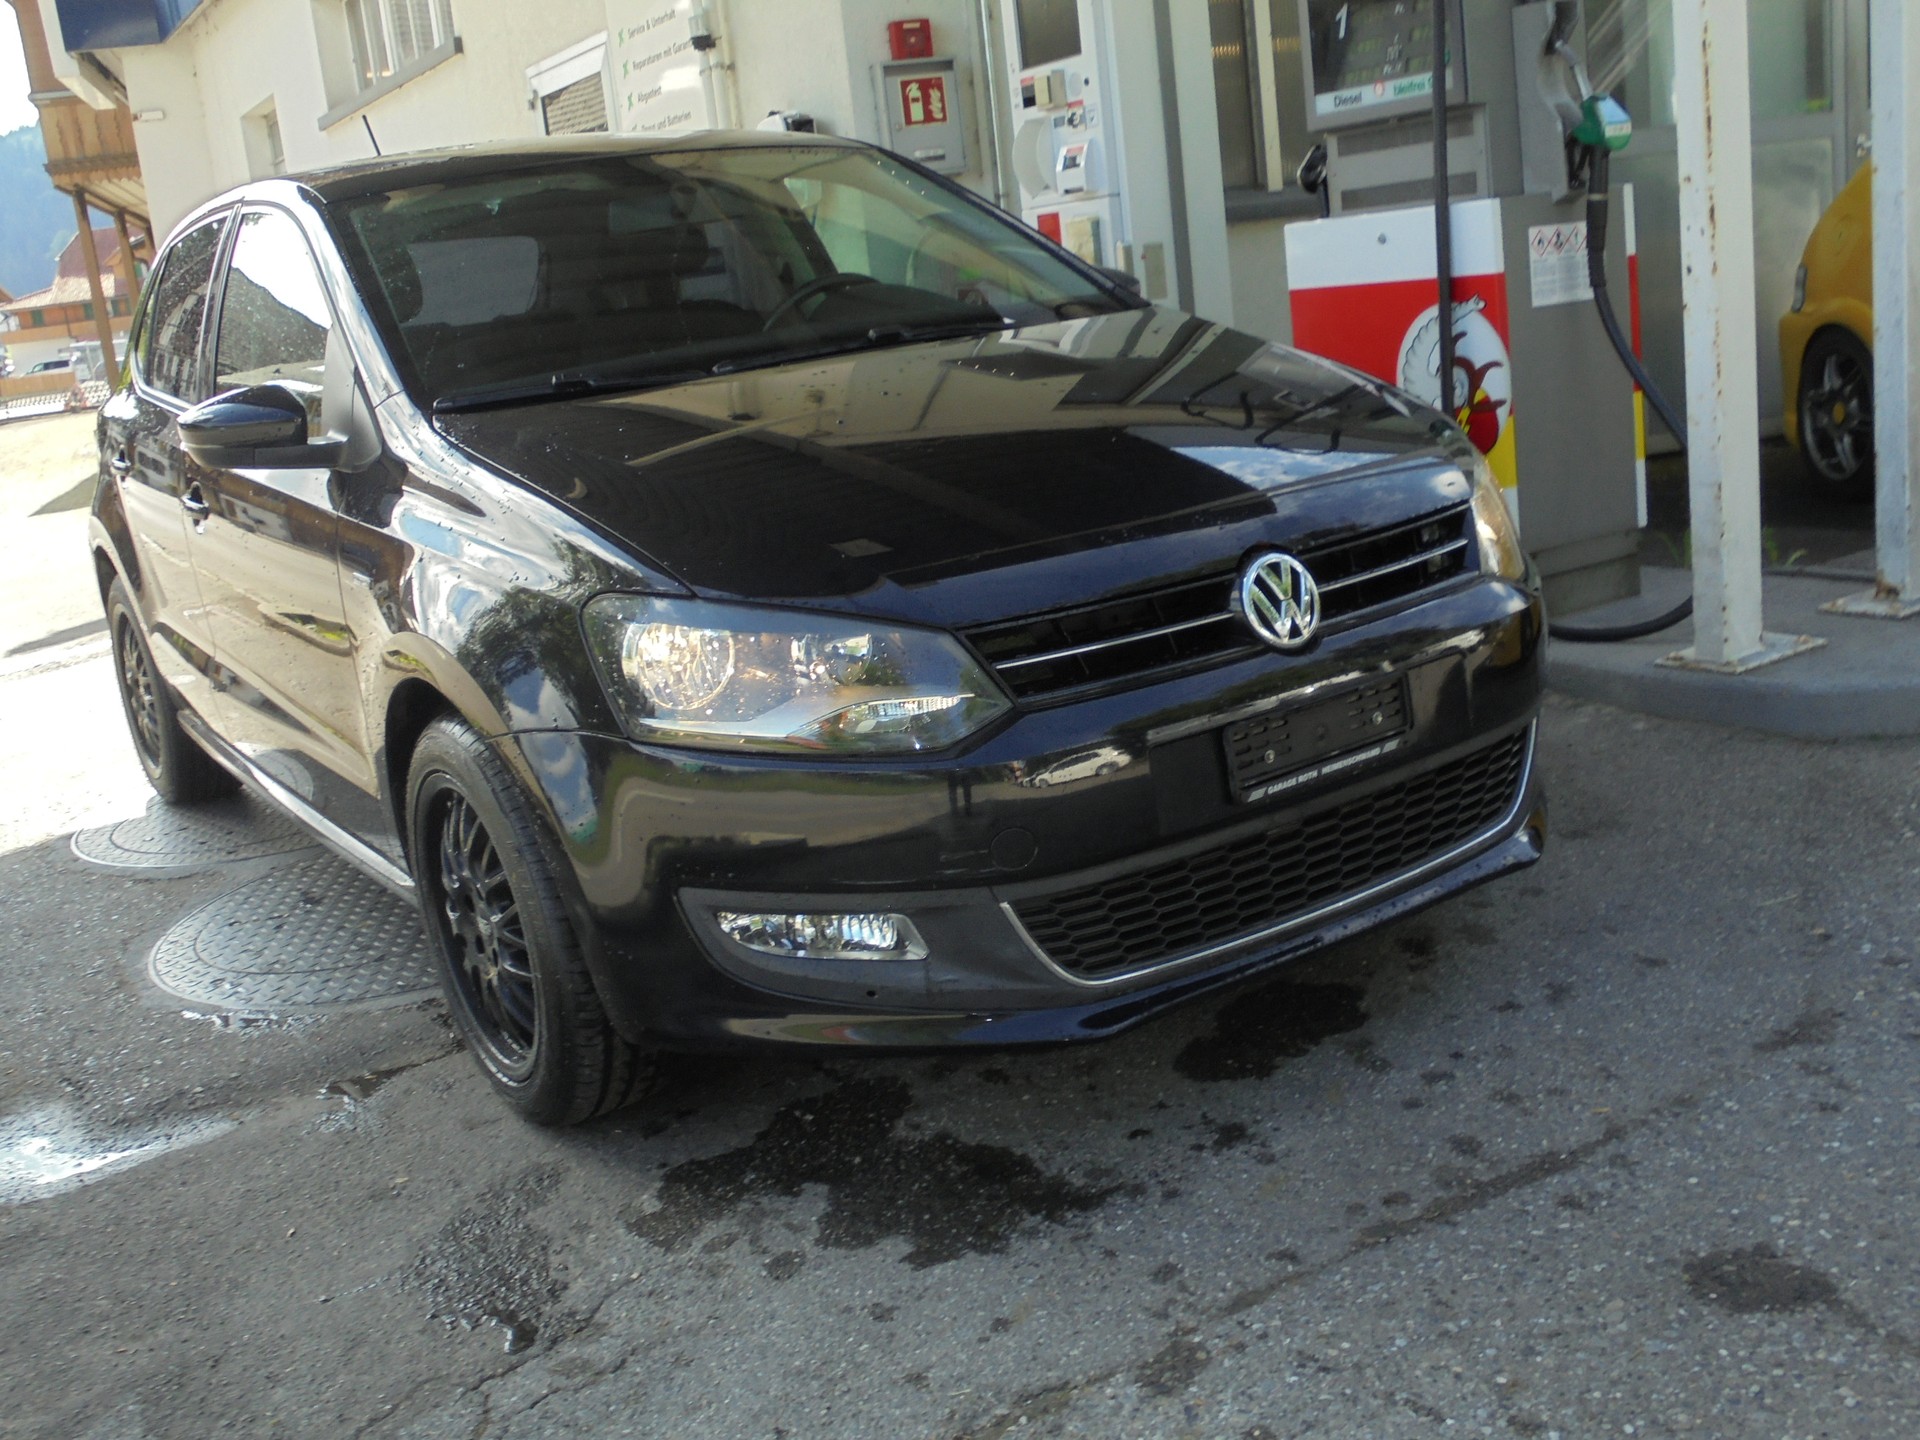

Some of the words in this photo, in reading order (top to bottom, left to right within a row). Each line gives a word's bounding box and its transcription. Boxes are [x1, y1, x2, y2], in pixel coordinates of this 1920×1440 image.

[1334, 91, 1362, 108] Diesel
[1244, 554, 1319, 646] VW
[1267, 777, 1297, 795] GARAGE
[1297, 769, 1318, 785] ROTH
